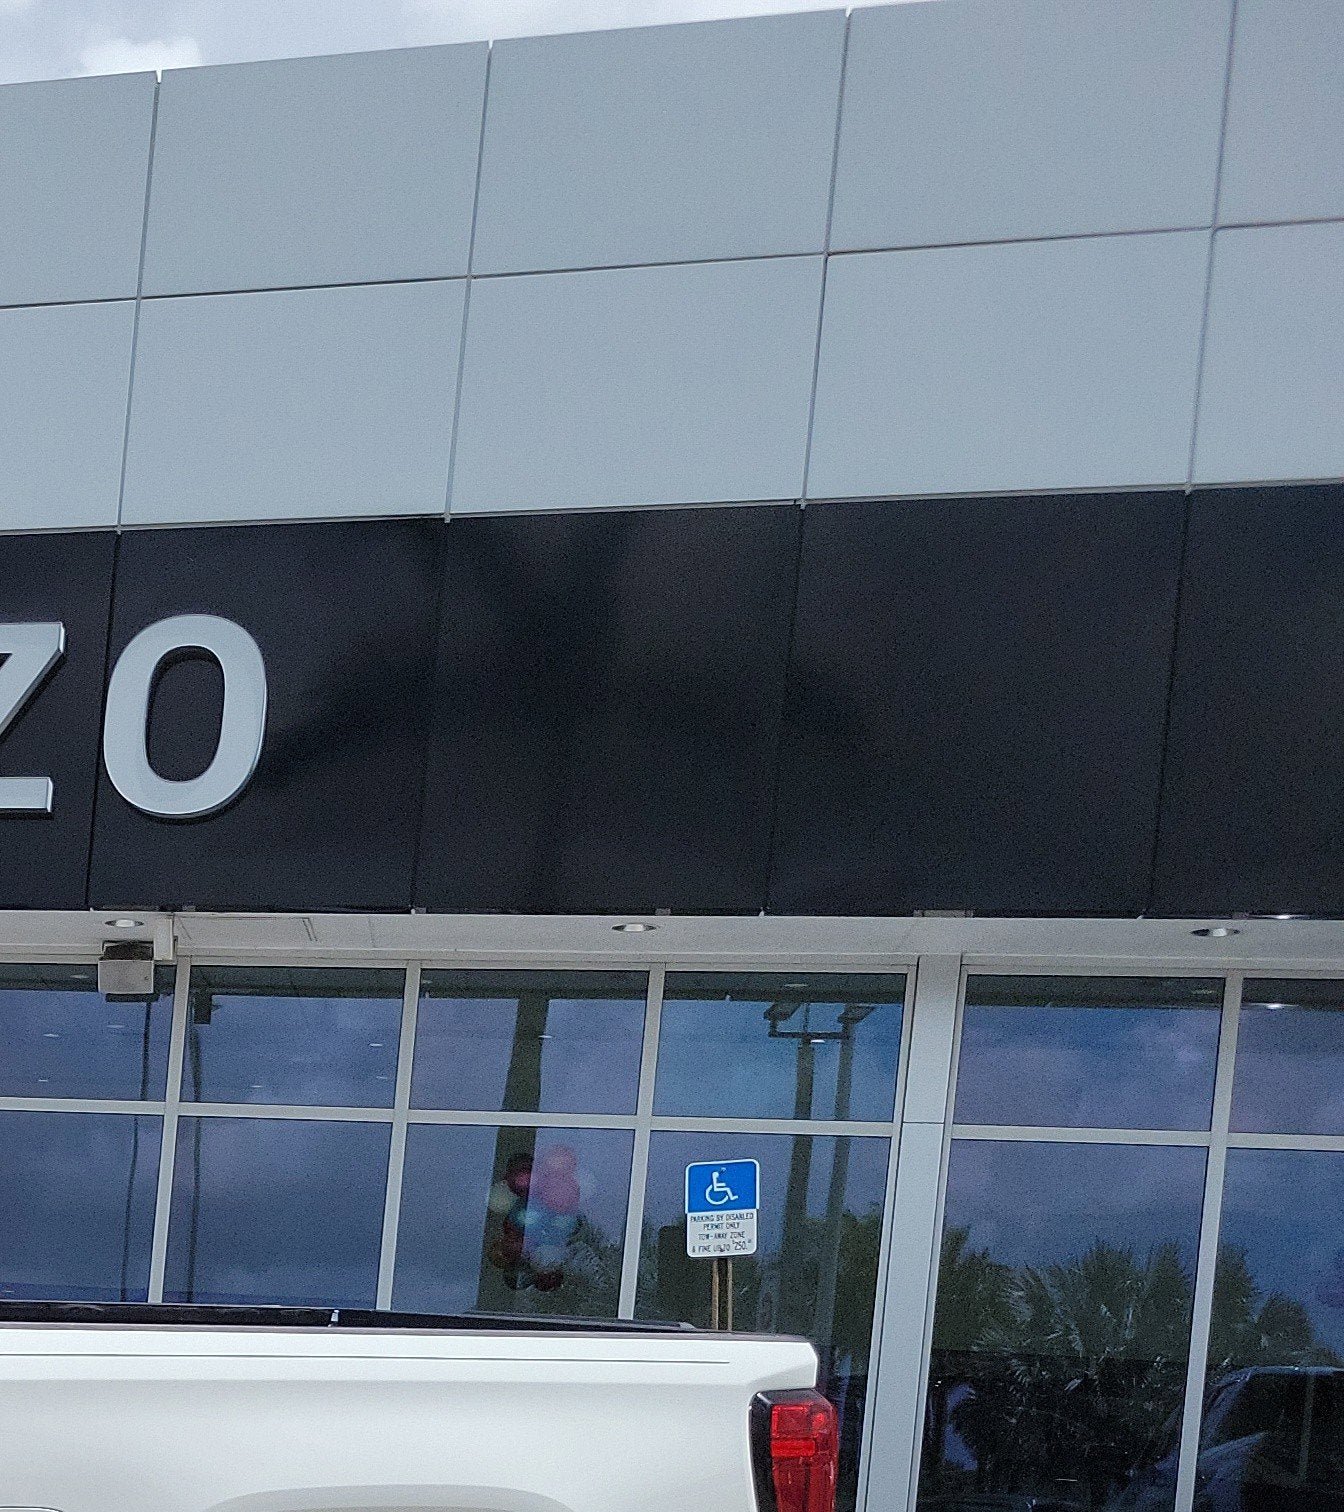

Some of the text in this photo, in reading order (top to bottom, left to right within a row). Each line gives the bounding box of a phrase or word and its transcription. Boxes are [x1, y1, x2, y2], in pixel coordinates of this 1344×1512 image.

[690, 1214, 714, 1222] PARKING
[726, 1212, 754, 1220] DISABLED
[703, 1222, 723, 1230] PERMIT
[698, 1231, 745, 1240] TOW-AWAY ZONE
[699, 1244, 712, 1253] FINE
